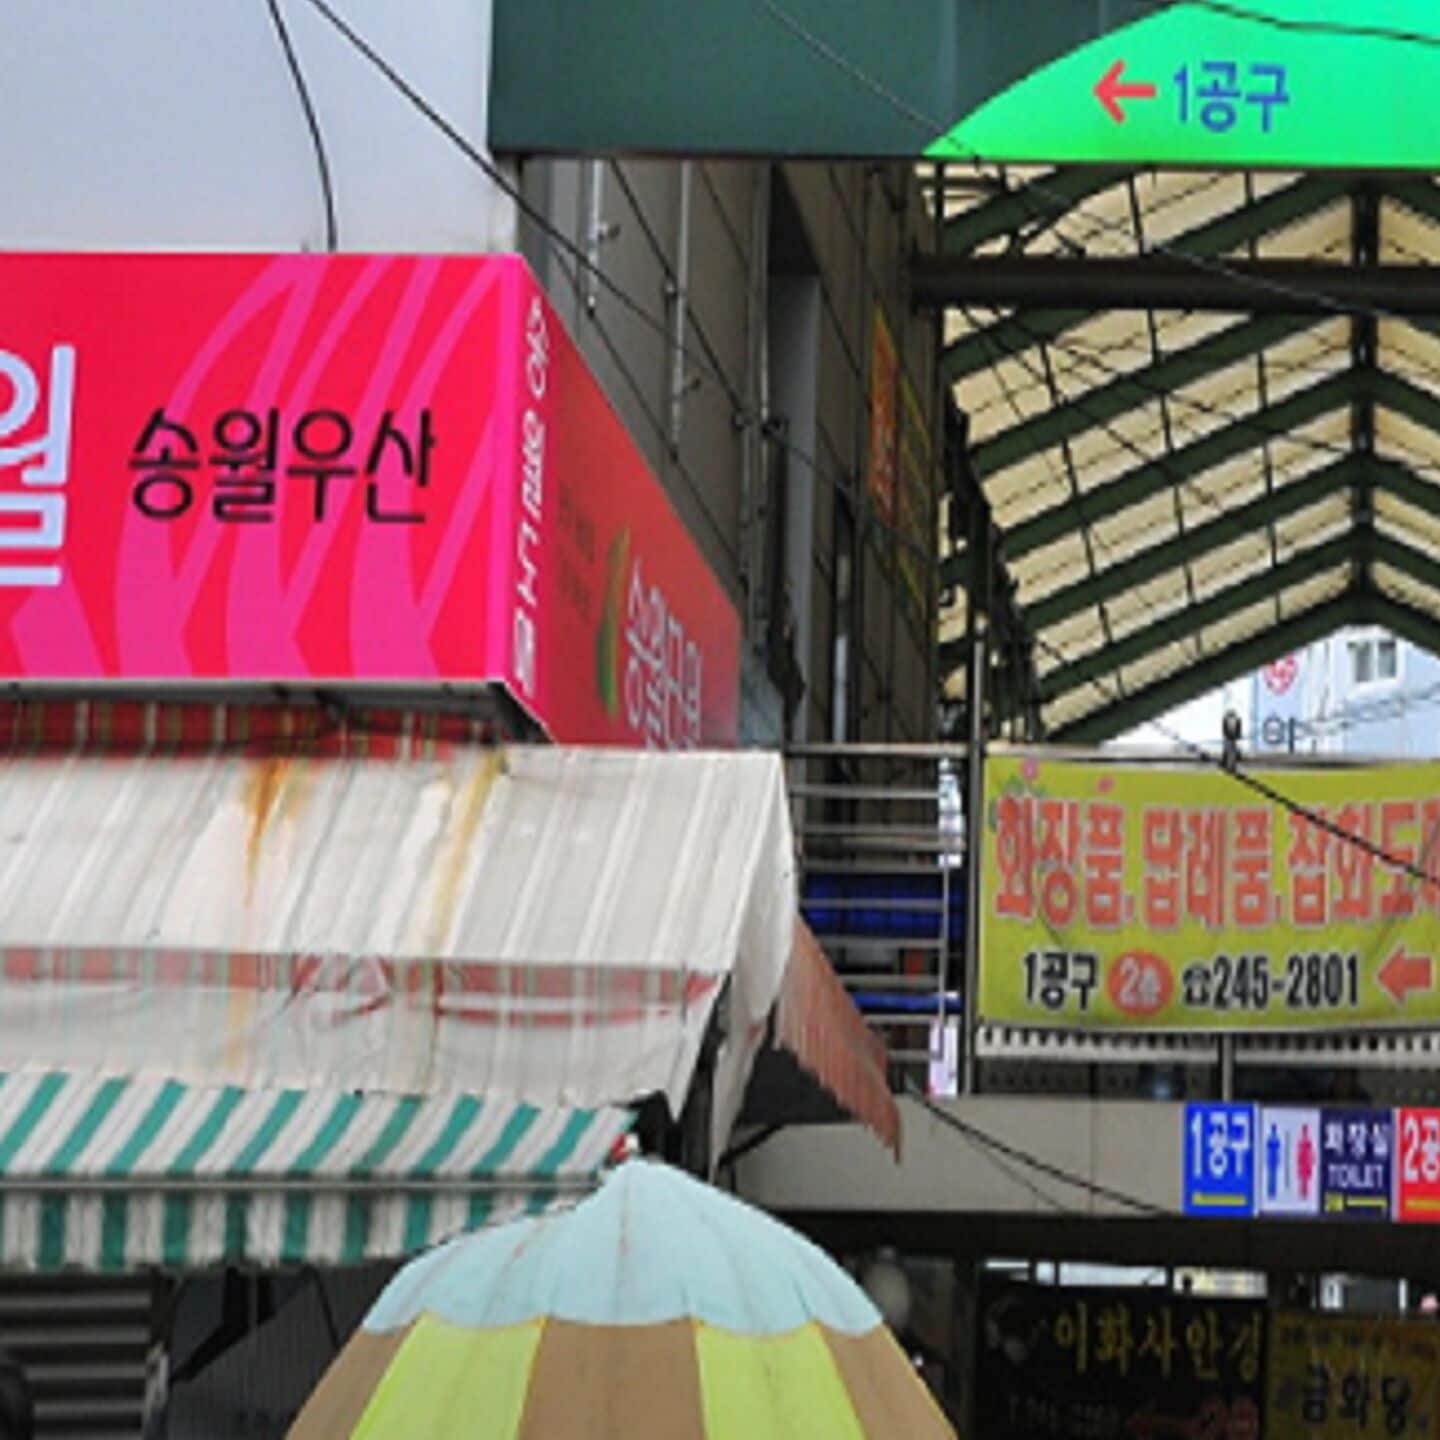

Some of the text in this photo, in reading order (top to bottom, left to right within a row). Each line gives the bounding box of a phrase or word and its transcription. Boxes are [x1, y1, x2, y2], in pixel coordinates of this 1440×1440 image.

[1174, 61, 1290, 132] 1공구
[128, 408, 435, 523] 송월우산
[1023, 953, 1097, 1010] 1공구
[1191, 1112, 1251, 1177] 1공구
